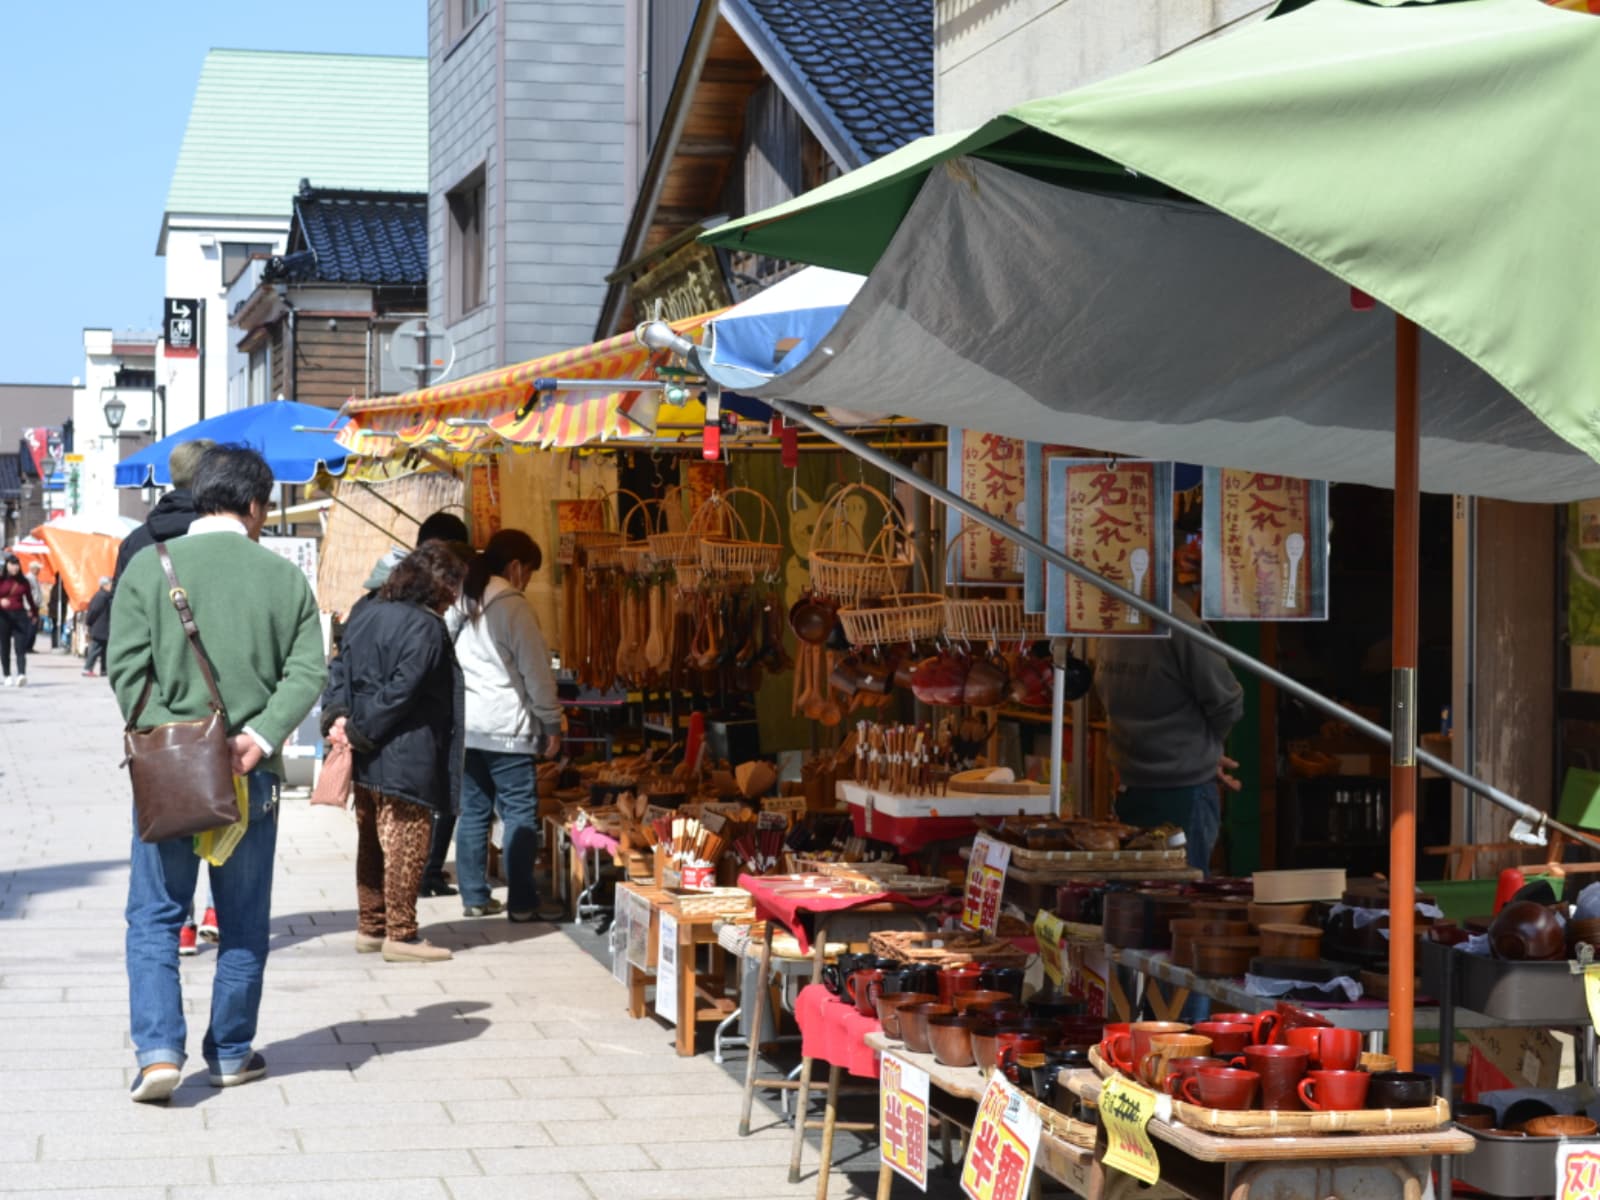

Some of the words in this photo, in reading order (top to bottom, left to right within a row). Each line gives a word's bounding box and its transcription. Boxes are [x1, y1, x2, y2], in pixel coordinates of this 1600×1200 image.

[965, 870, 998, 929] 半額
[885, 1094, 924, 1173] 半額
[972, 1120, 1025, 1200] 半額
